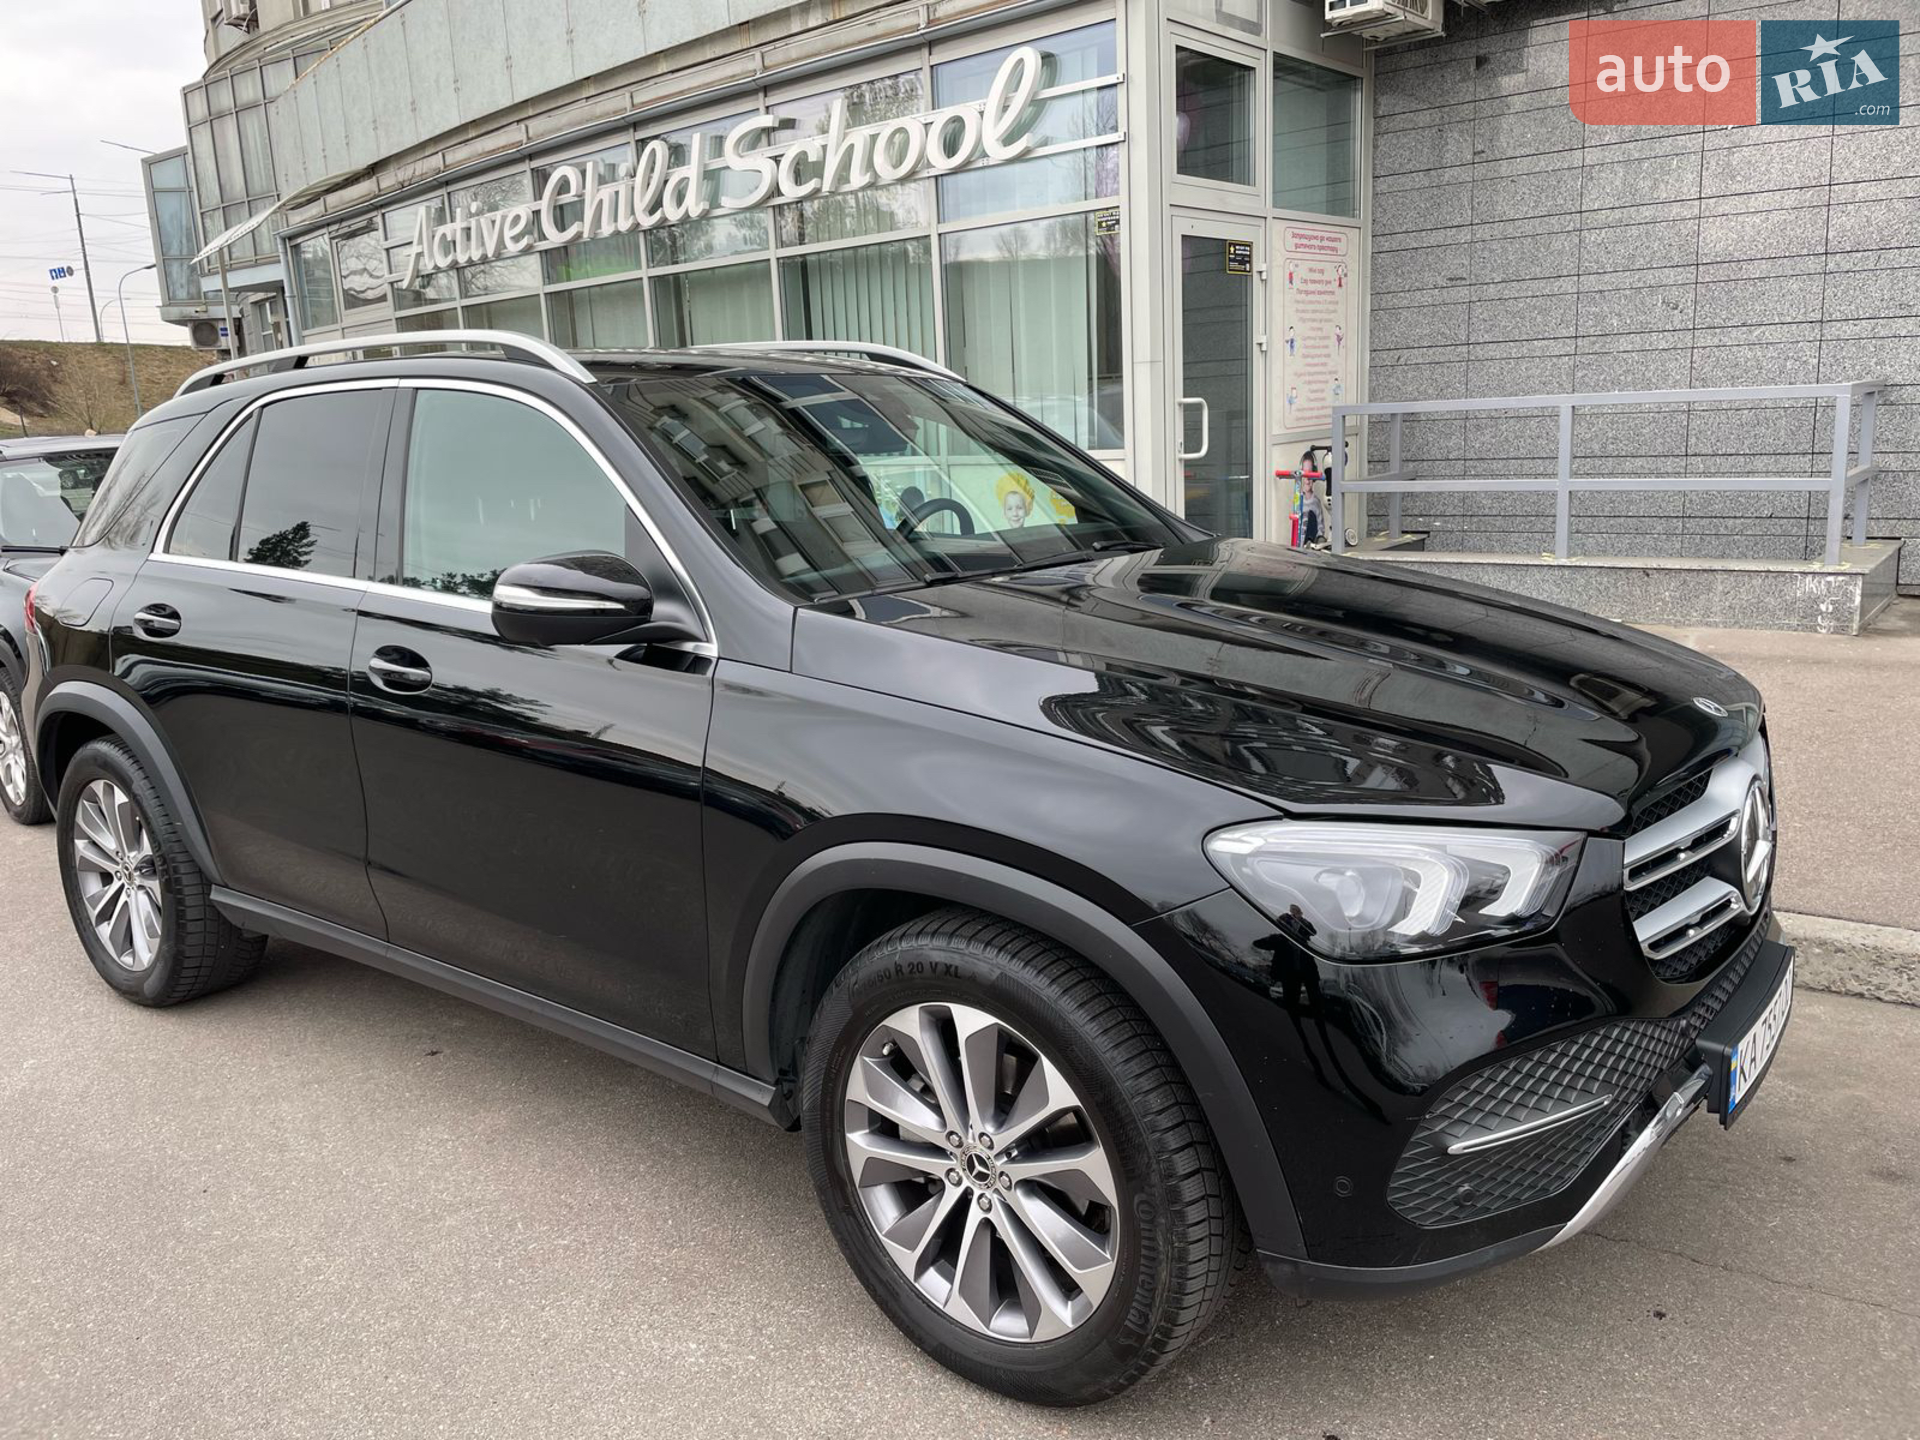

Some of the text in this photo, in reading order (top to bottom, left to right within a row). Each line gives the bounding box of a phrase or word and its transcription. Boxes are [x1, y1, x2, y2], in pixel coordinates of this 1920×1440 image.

[400, 45, 1043, 291] Active Child School
[907, 961, 925, 975] 20
[929, 961, 939, 974] V
[944, 963, 962, 980] XL
